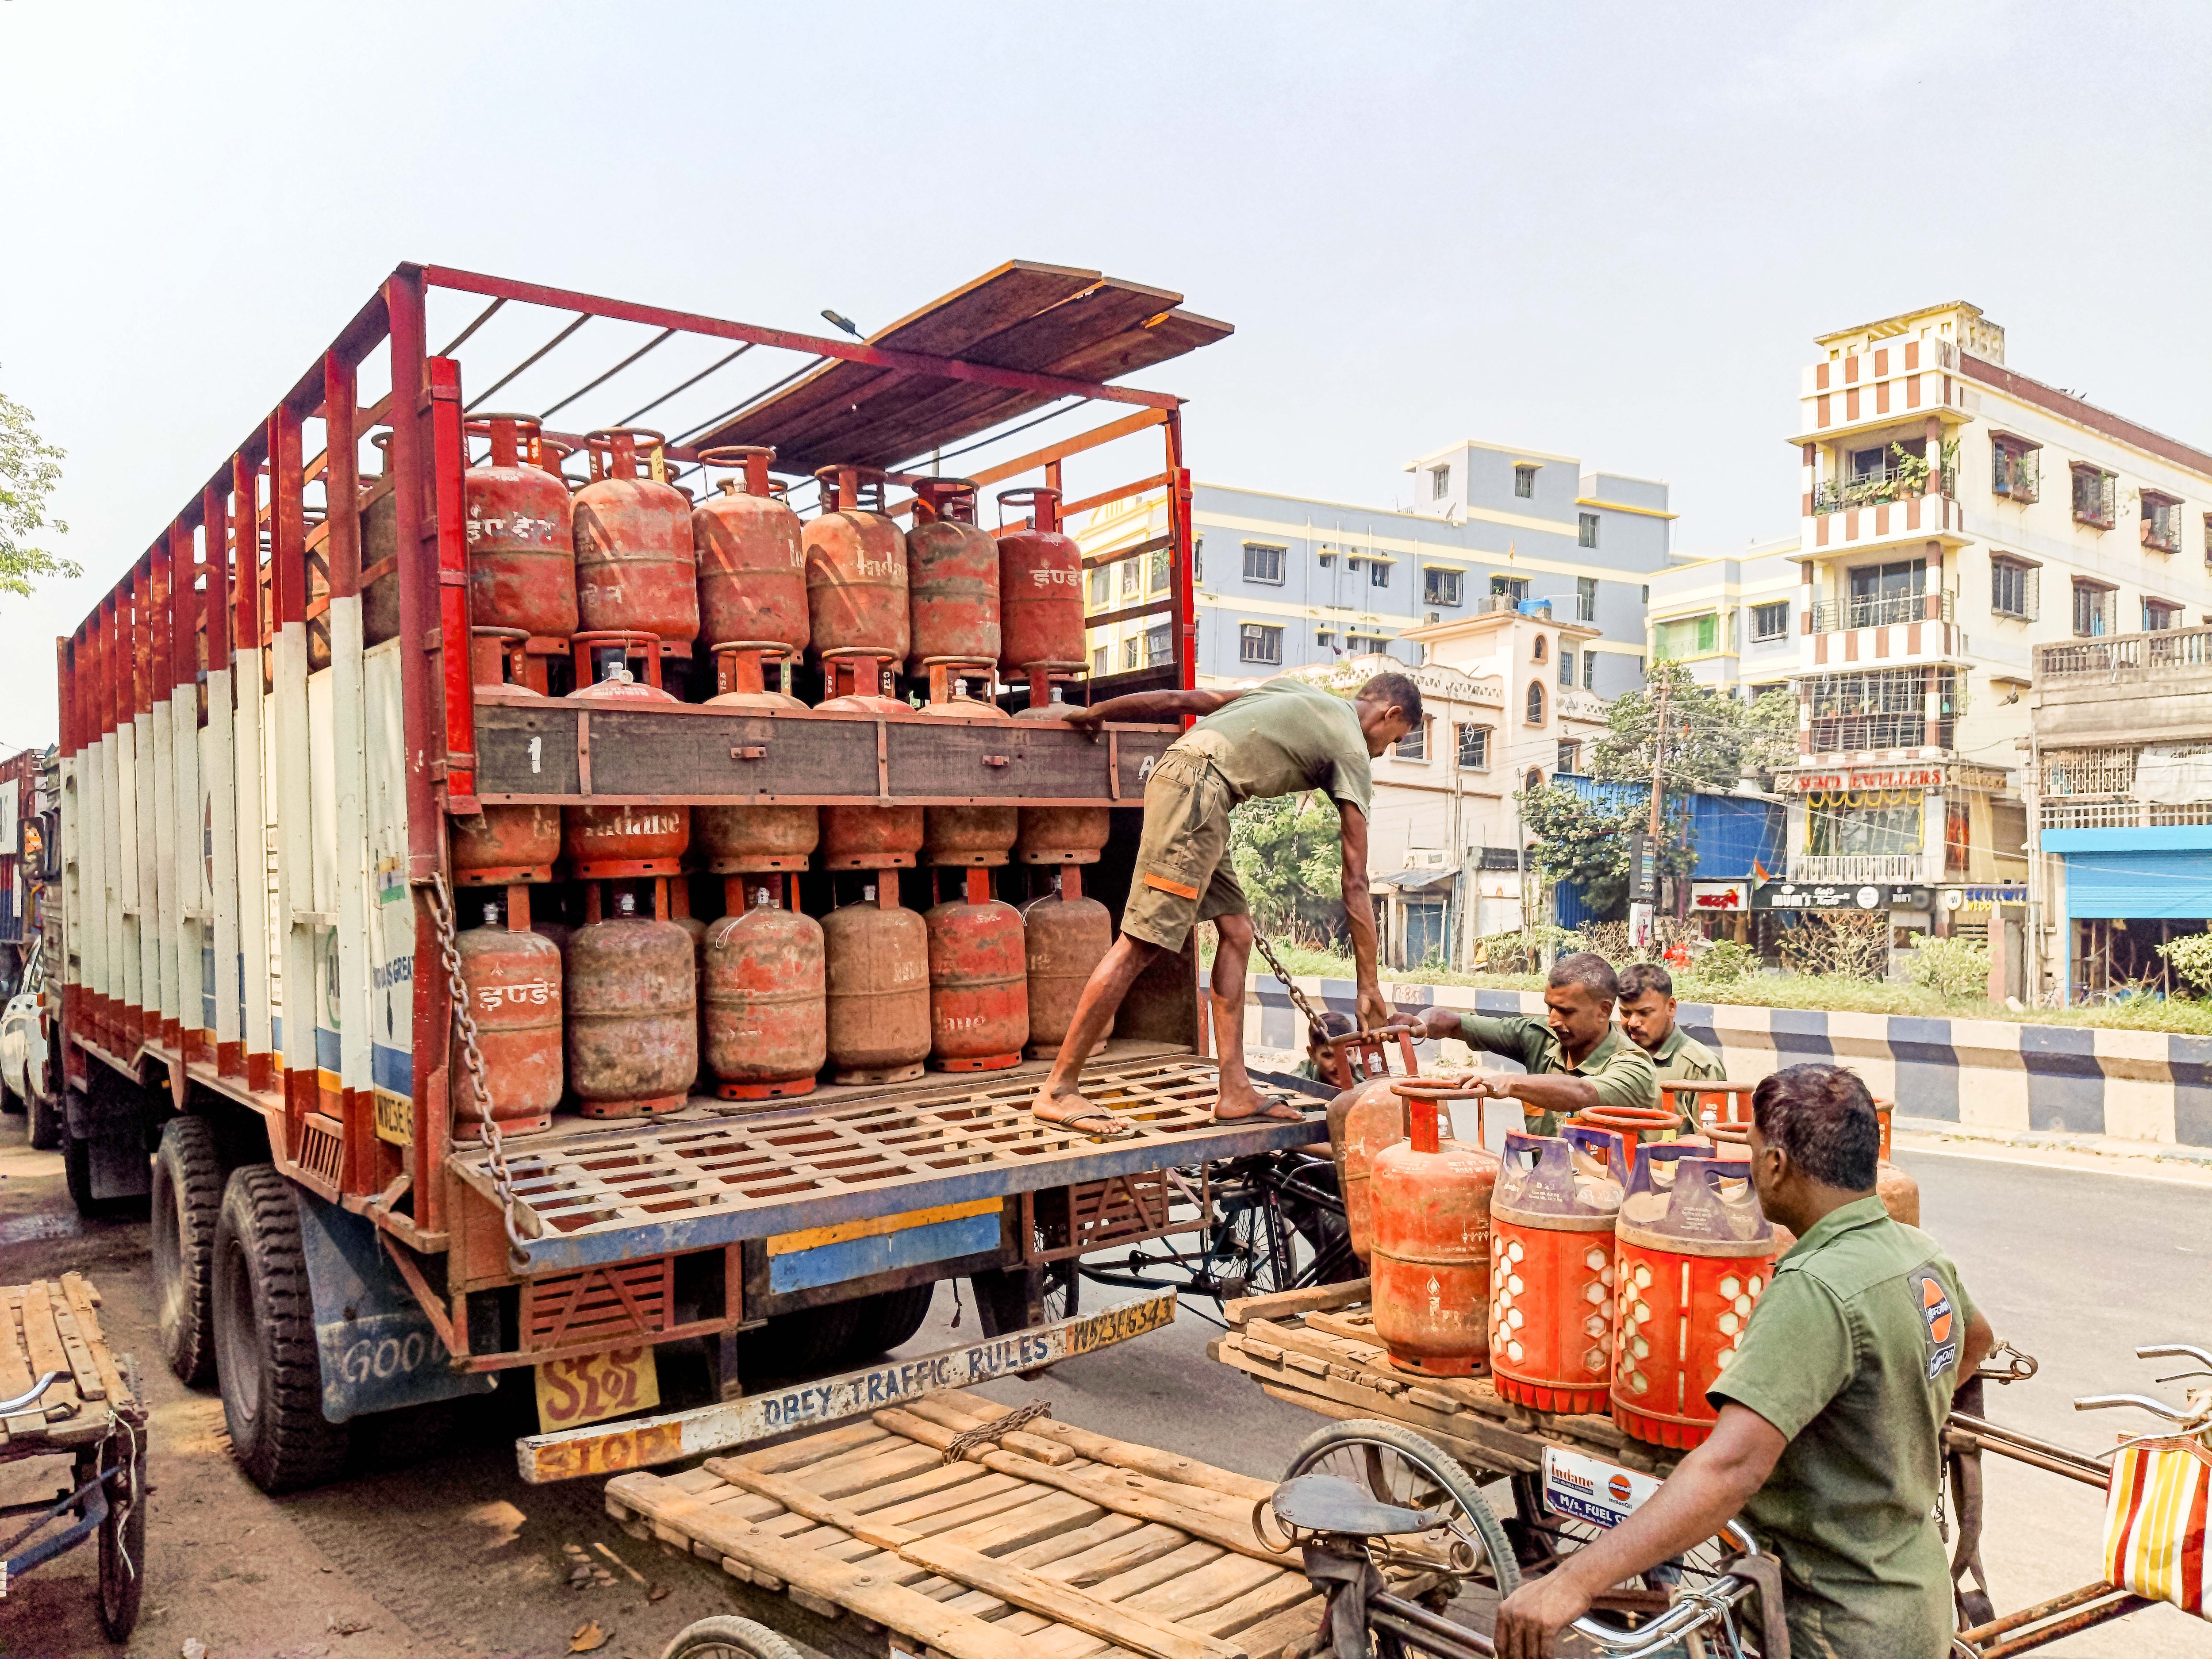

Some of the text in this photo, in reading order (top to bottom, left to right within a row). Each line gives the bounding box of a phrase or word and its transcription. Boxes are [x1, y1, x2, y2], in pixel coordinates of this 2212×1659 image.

[764, 1385, 833, 1425] OBEY
[847, 1356, 951, 1402] TRAFFIC
[965, 1335, 1048, 1379] RULES
[1551, 1463, 1594, 1488] Indane
[1560, 1494, 1582, 1511] M/s.
[1586, 1503, 1613, 1521] FUEL
